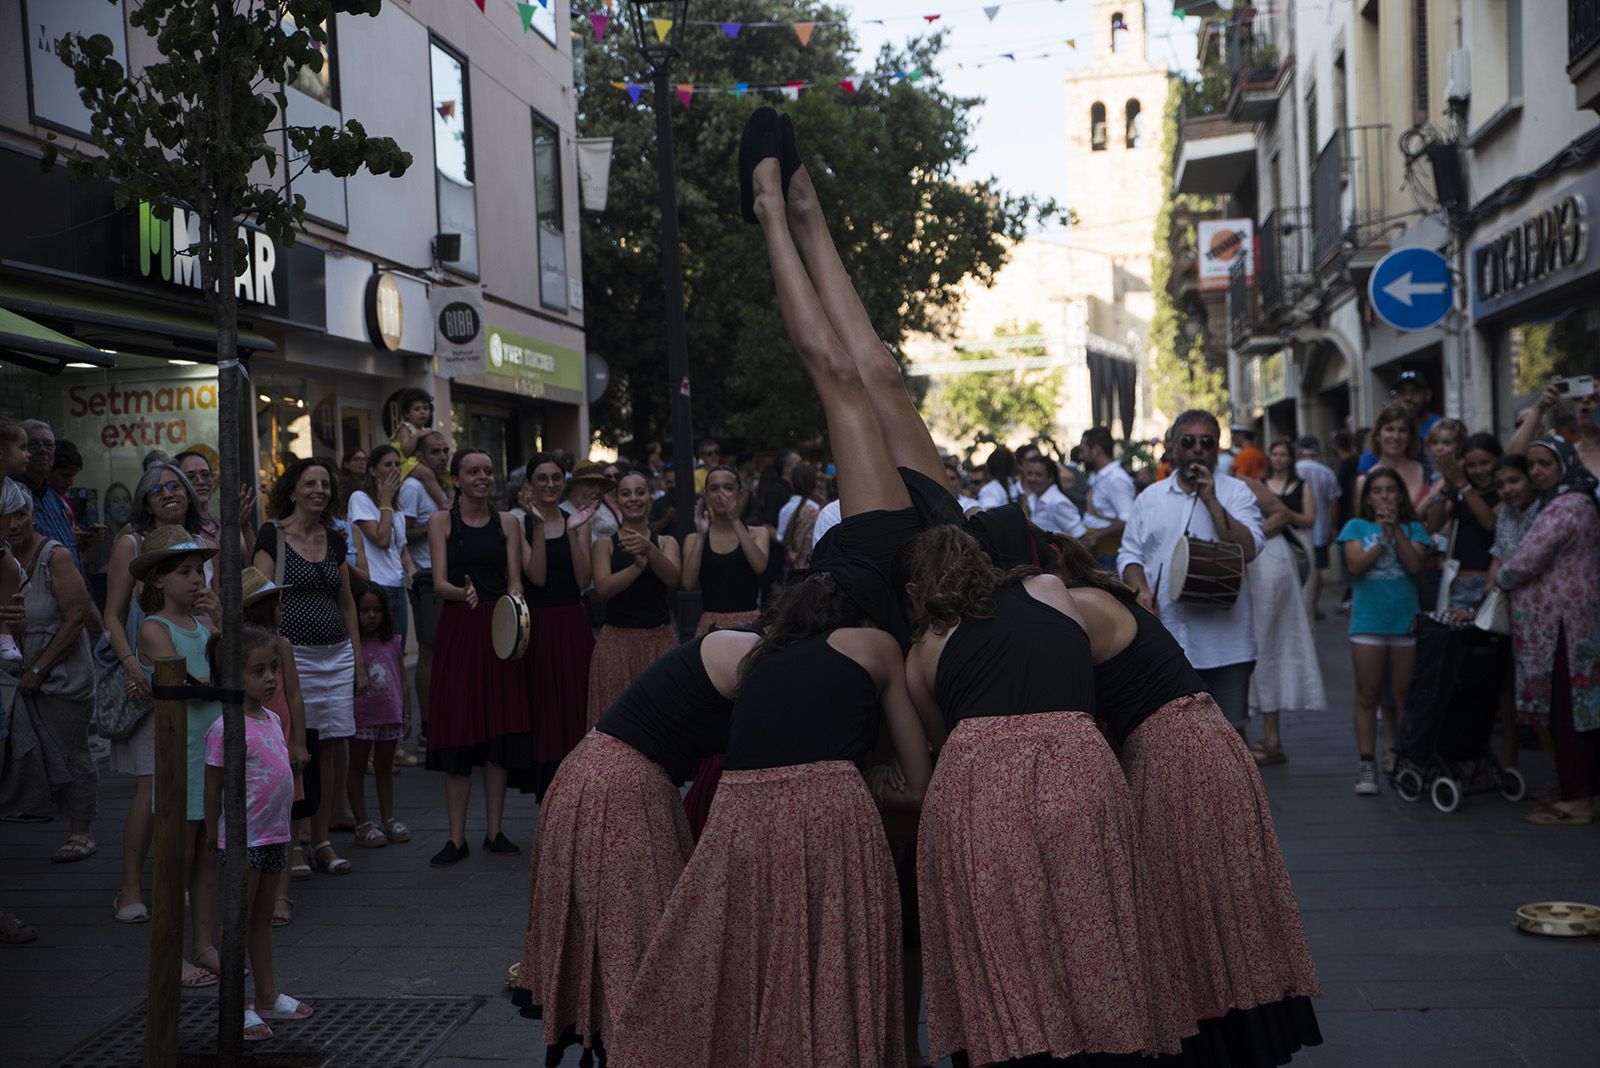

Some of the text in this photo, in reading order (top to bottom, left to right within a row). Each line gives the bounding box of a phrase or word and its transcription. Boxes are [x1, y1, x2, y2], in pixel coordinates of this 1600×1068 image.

[445, 308, 474, 338] BIBA
[69, 384, 217, 417] Setmana
[101, 416, 187, 448] extra
